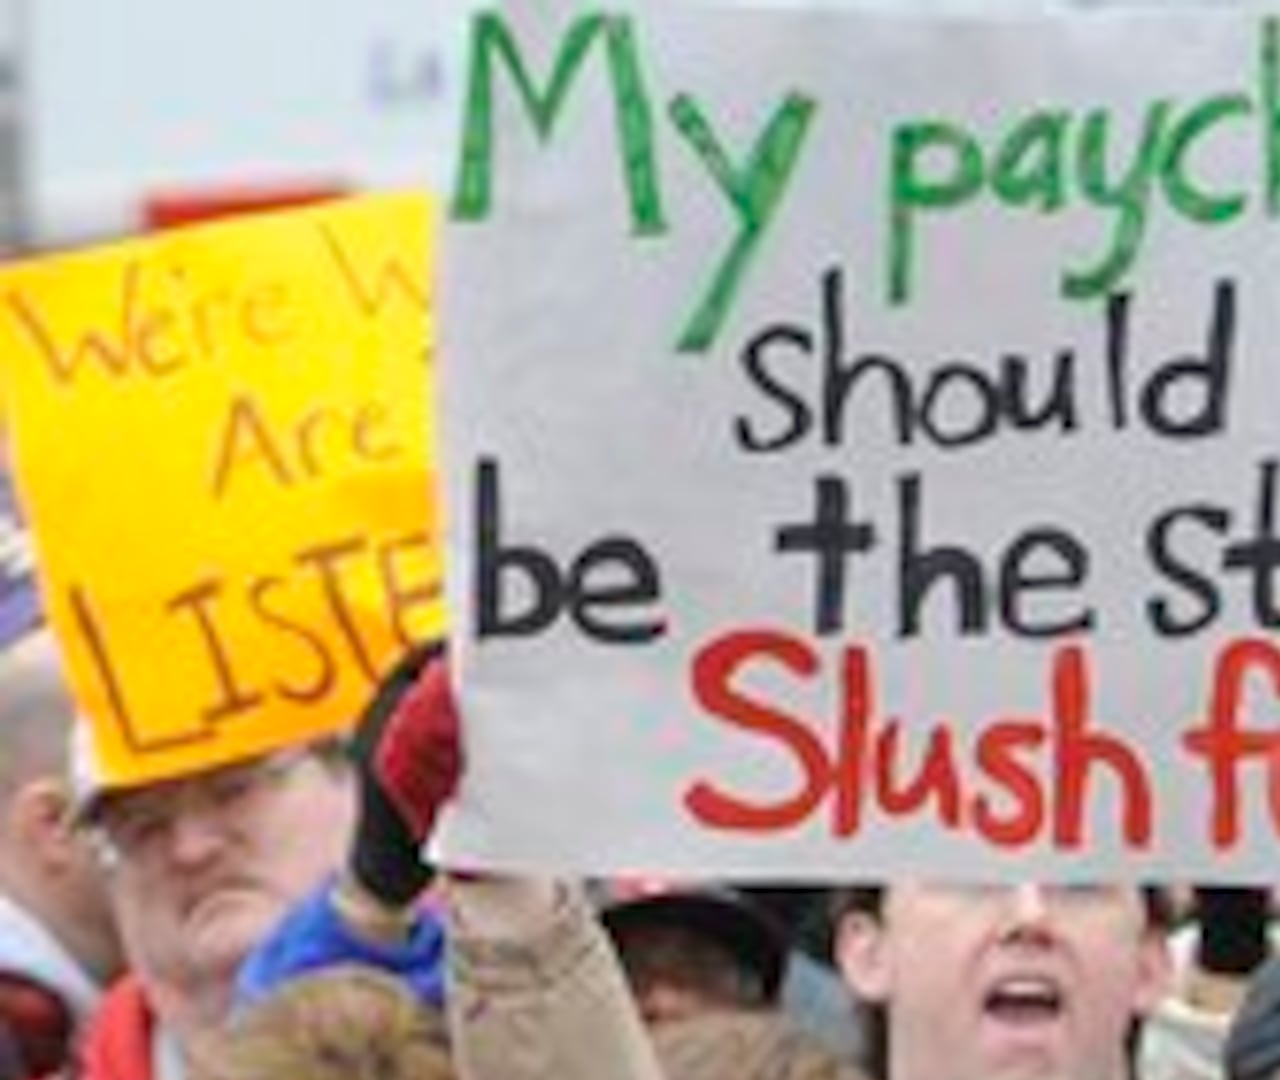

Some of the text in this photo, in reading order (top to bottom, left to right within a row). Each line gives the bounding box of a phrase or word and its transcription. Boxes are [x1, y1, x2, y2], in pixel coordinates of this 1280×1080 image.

[449, 10, 816, 353] My
[6, 257, 290, 384] We're
[735, 267, 1236, 454] should
[210, 394, 402, 503] Are
[474, 456, 667, 643] be
[775, 472, 1094, 640] the
